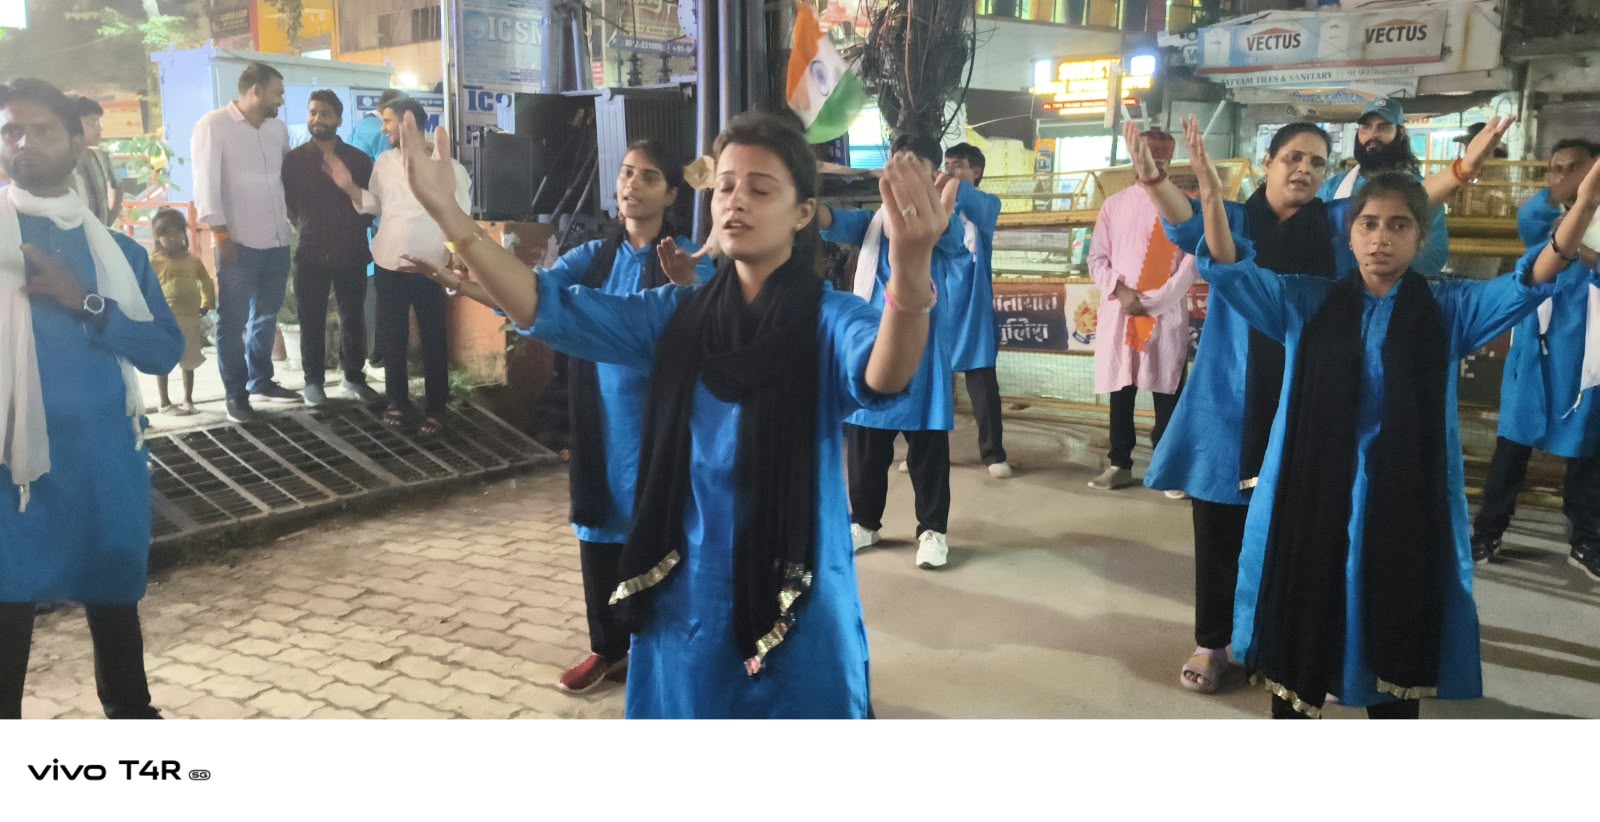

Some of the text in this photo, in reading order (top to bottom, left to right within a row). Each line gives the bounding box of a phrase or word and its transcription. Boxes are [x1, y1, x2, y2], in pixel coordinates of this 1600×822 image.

[1246, 32, 1302, 52] VECTUS
[1365, 24, 1428, 44] VECTUS
[1256, 75, 1279, 84] TILES
[1289, 71, 1333, 81] SANITARY
